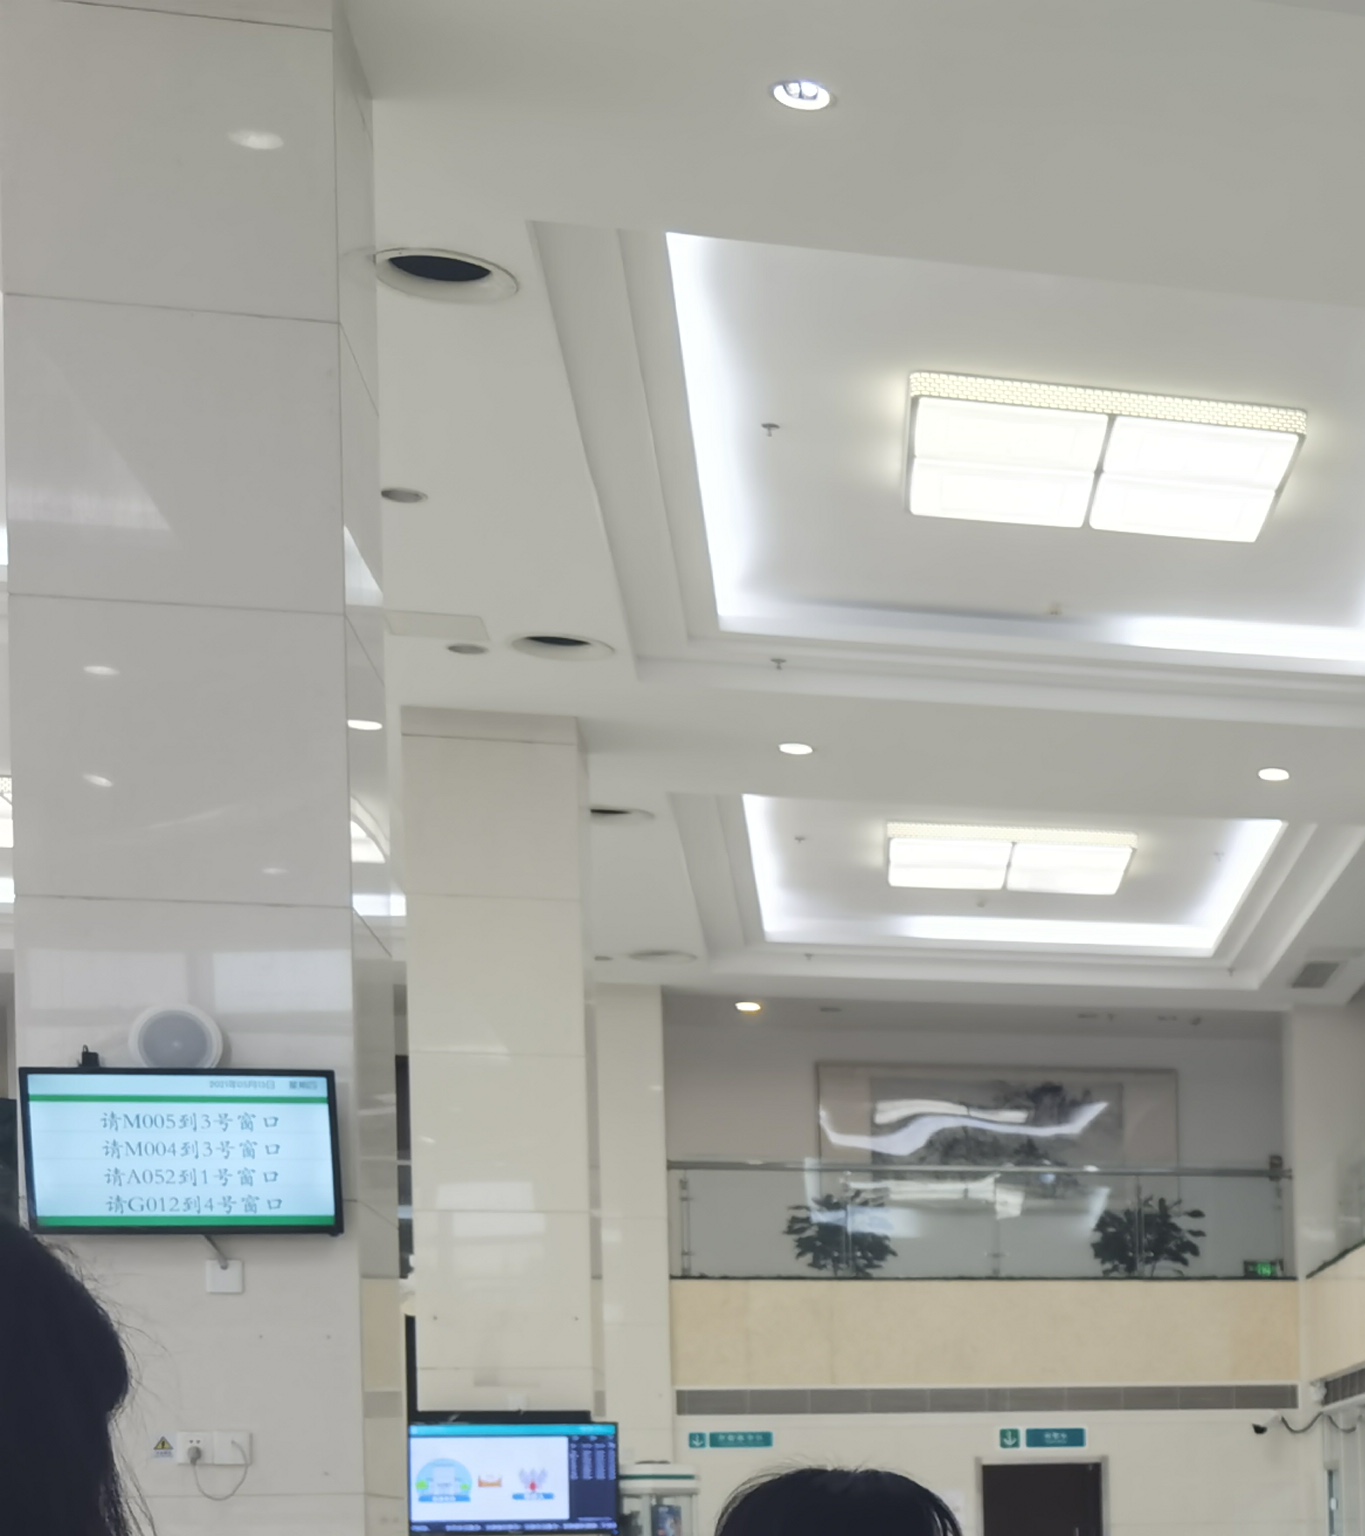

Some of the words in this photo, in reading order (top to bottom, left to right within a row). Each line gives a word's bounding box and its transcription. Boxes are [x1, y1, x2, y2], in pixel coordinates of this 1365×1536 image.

[100, 1111, 280, 1132] 请M005到3号窗口
[102, 1139, 281, 1160] 请M004到3号窗口
[104, 1167, 279, 1187] 请A052到1号窗口
[105, 1194, 283, 1215] 请G012到4号窗口
